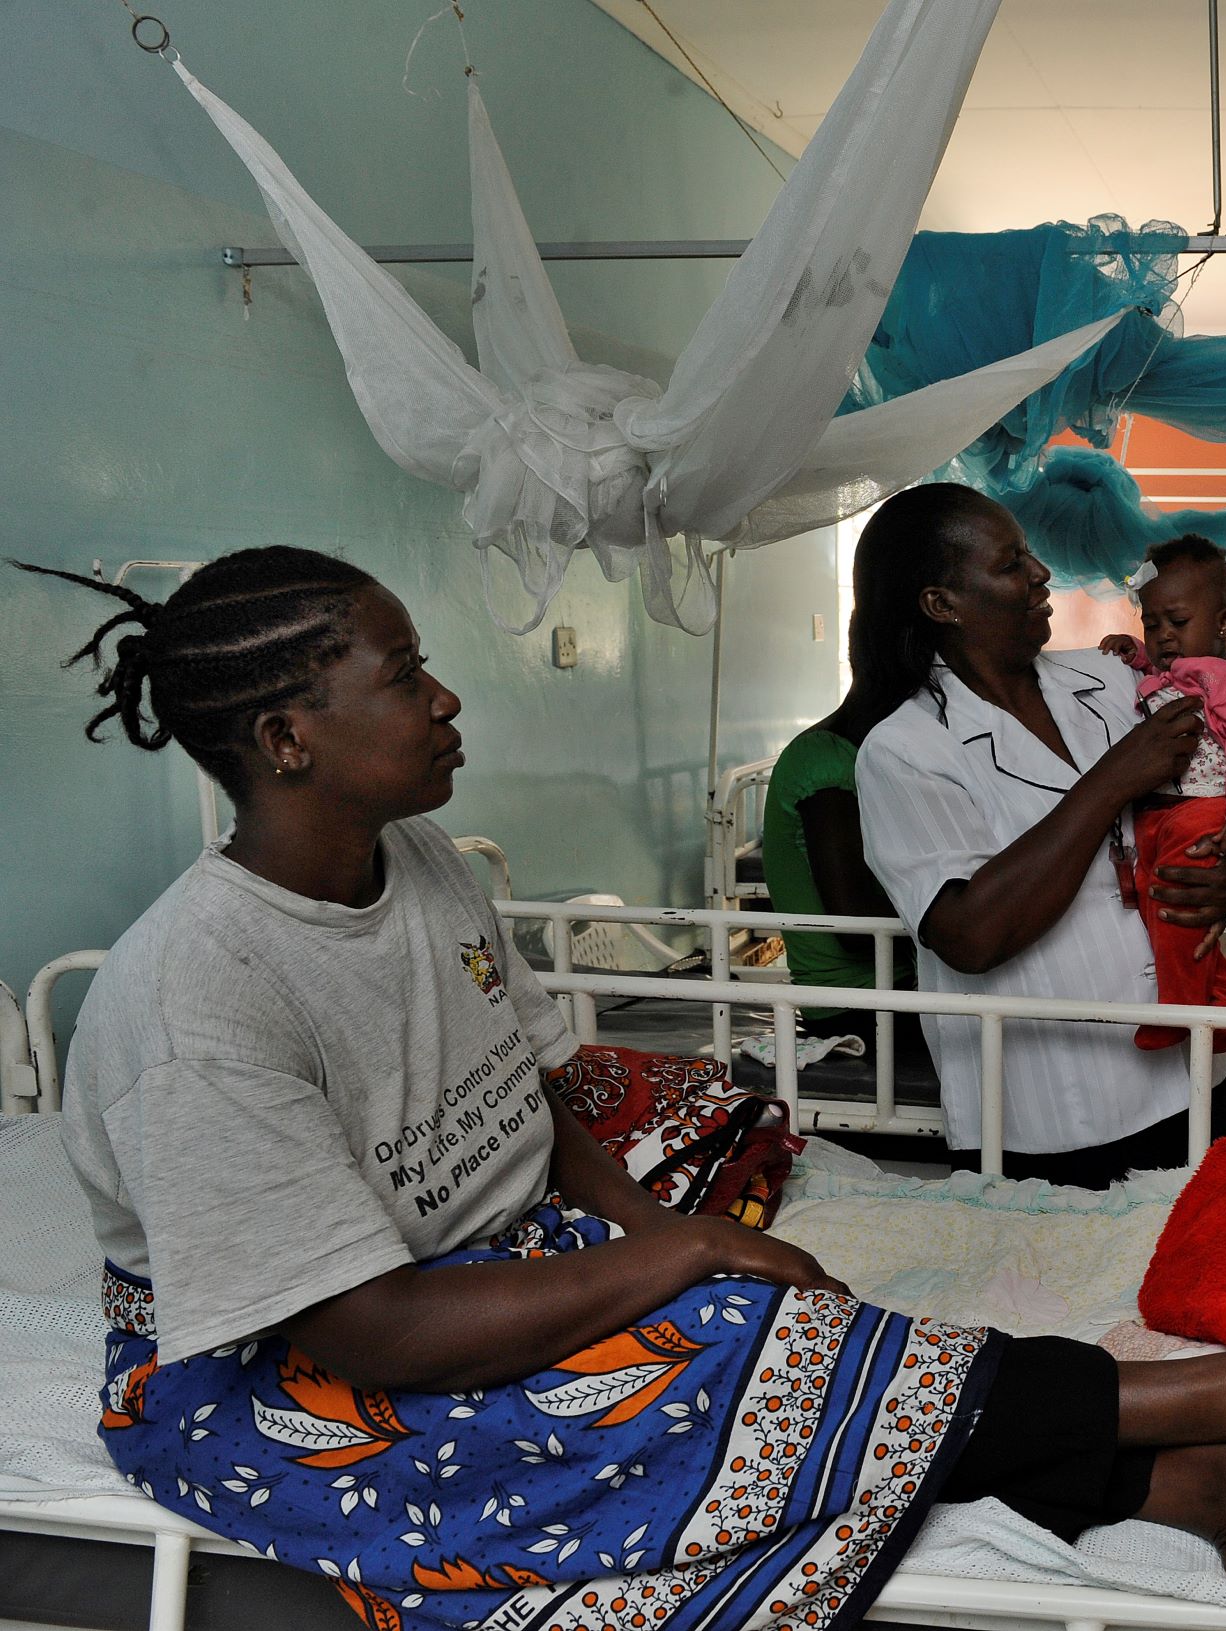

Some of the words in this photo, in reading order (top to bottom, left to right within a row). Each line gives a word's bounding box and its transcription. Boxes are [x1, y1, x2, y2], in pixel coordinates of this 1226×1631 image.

[443, 1055, 496, 1107] Control
[489, 1028, 523, 1063] Your
[389, 1159, 426, 1192] My
[414, 1185, 450, 1218] No
[450, 1135, 501, 1189] Place
[498, 1108, 526, 1139] for
[523, 1088, 545, 1114] Dr
[481, 1594, 536, 1631] HE
